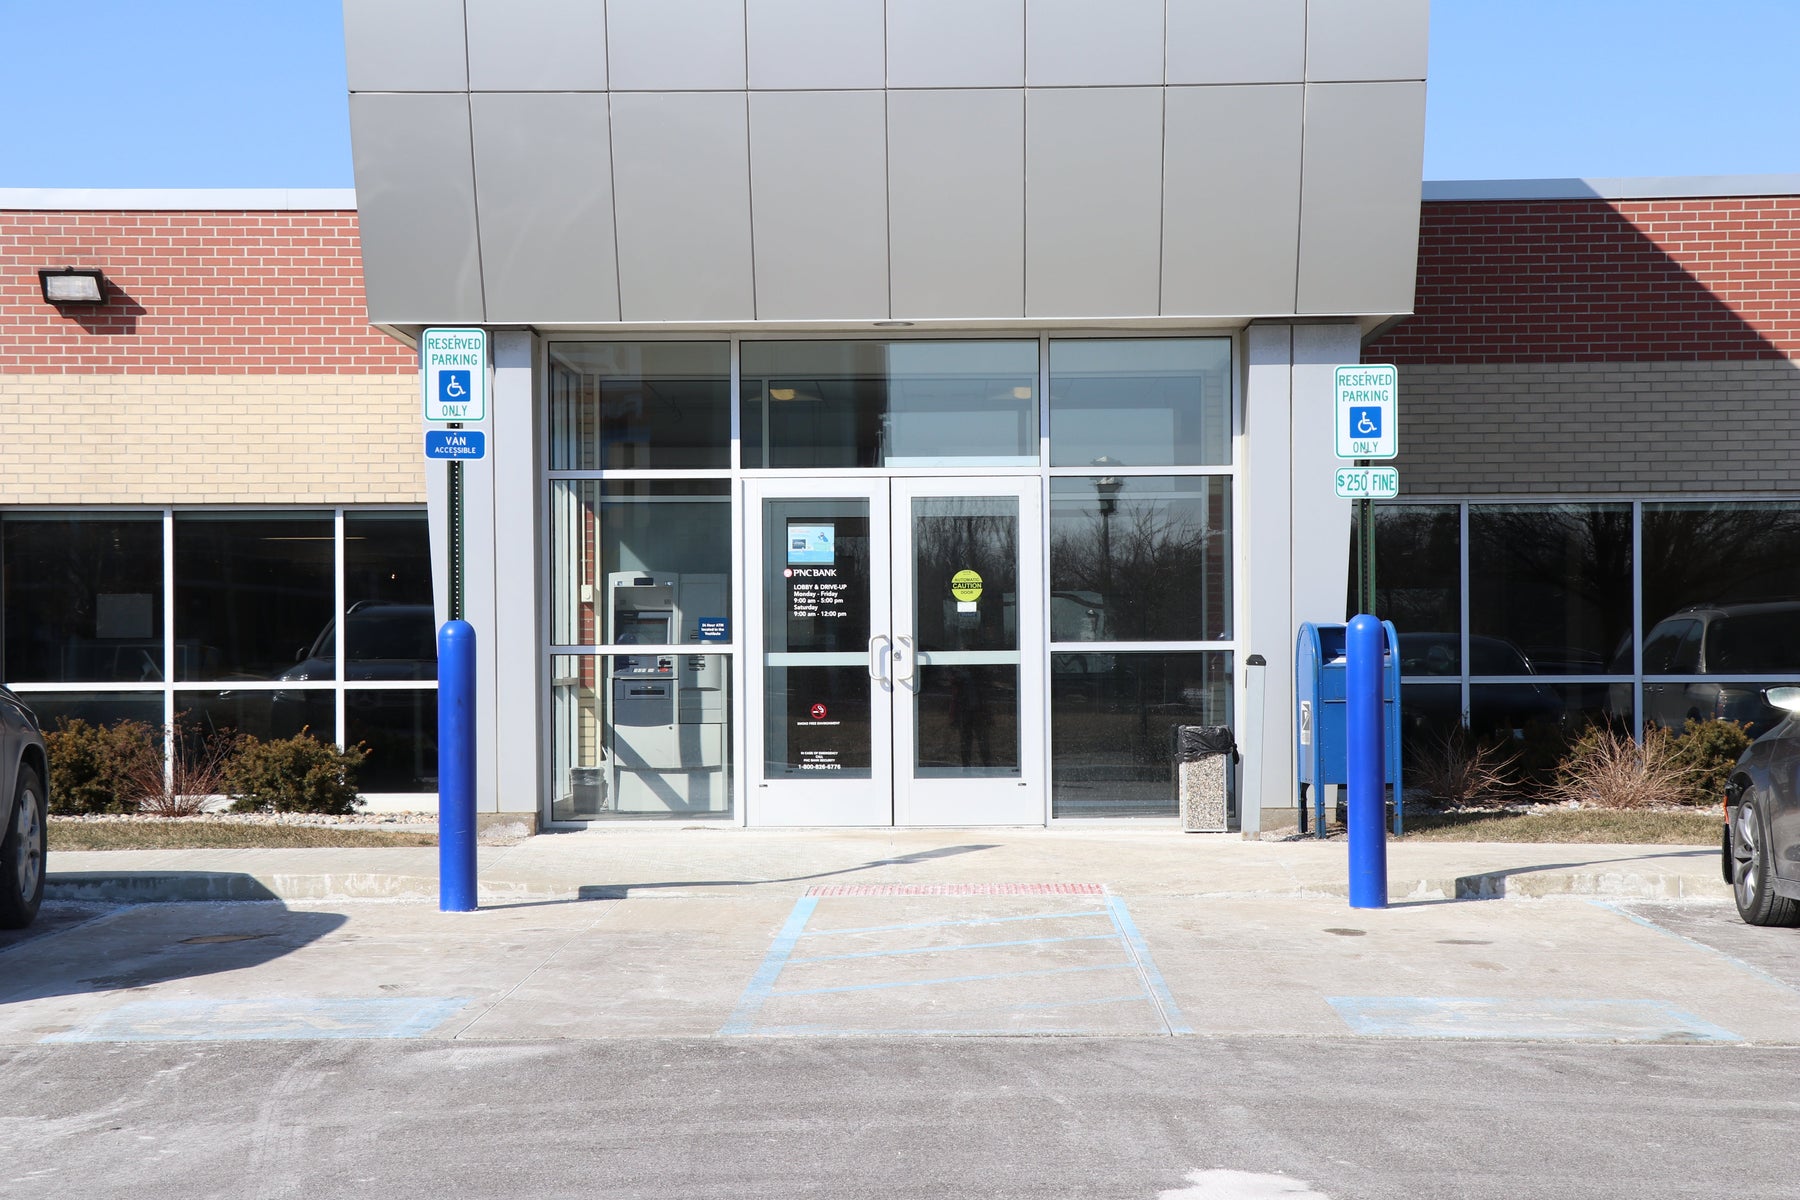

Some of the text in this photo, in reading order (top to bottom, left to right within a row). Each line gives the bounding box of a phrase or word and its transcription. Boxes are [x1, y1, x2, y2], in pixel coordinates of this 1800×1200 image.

[428, 338, 481, 350] RESERVED
[432, 354, 478, 366] PARKING
[1339, 374, 1392, 386] RESERVED
[1342, 390, 1388, 402] PARKING
[442, 405, 468, 416] ONLY
[446, 436, 466, 446] VAN
[1353, 442, 1378, 453] ONLY
[1372, 474, 1395, 491] FINE
